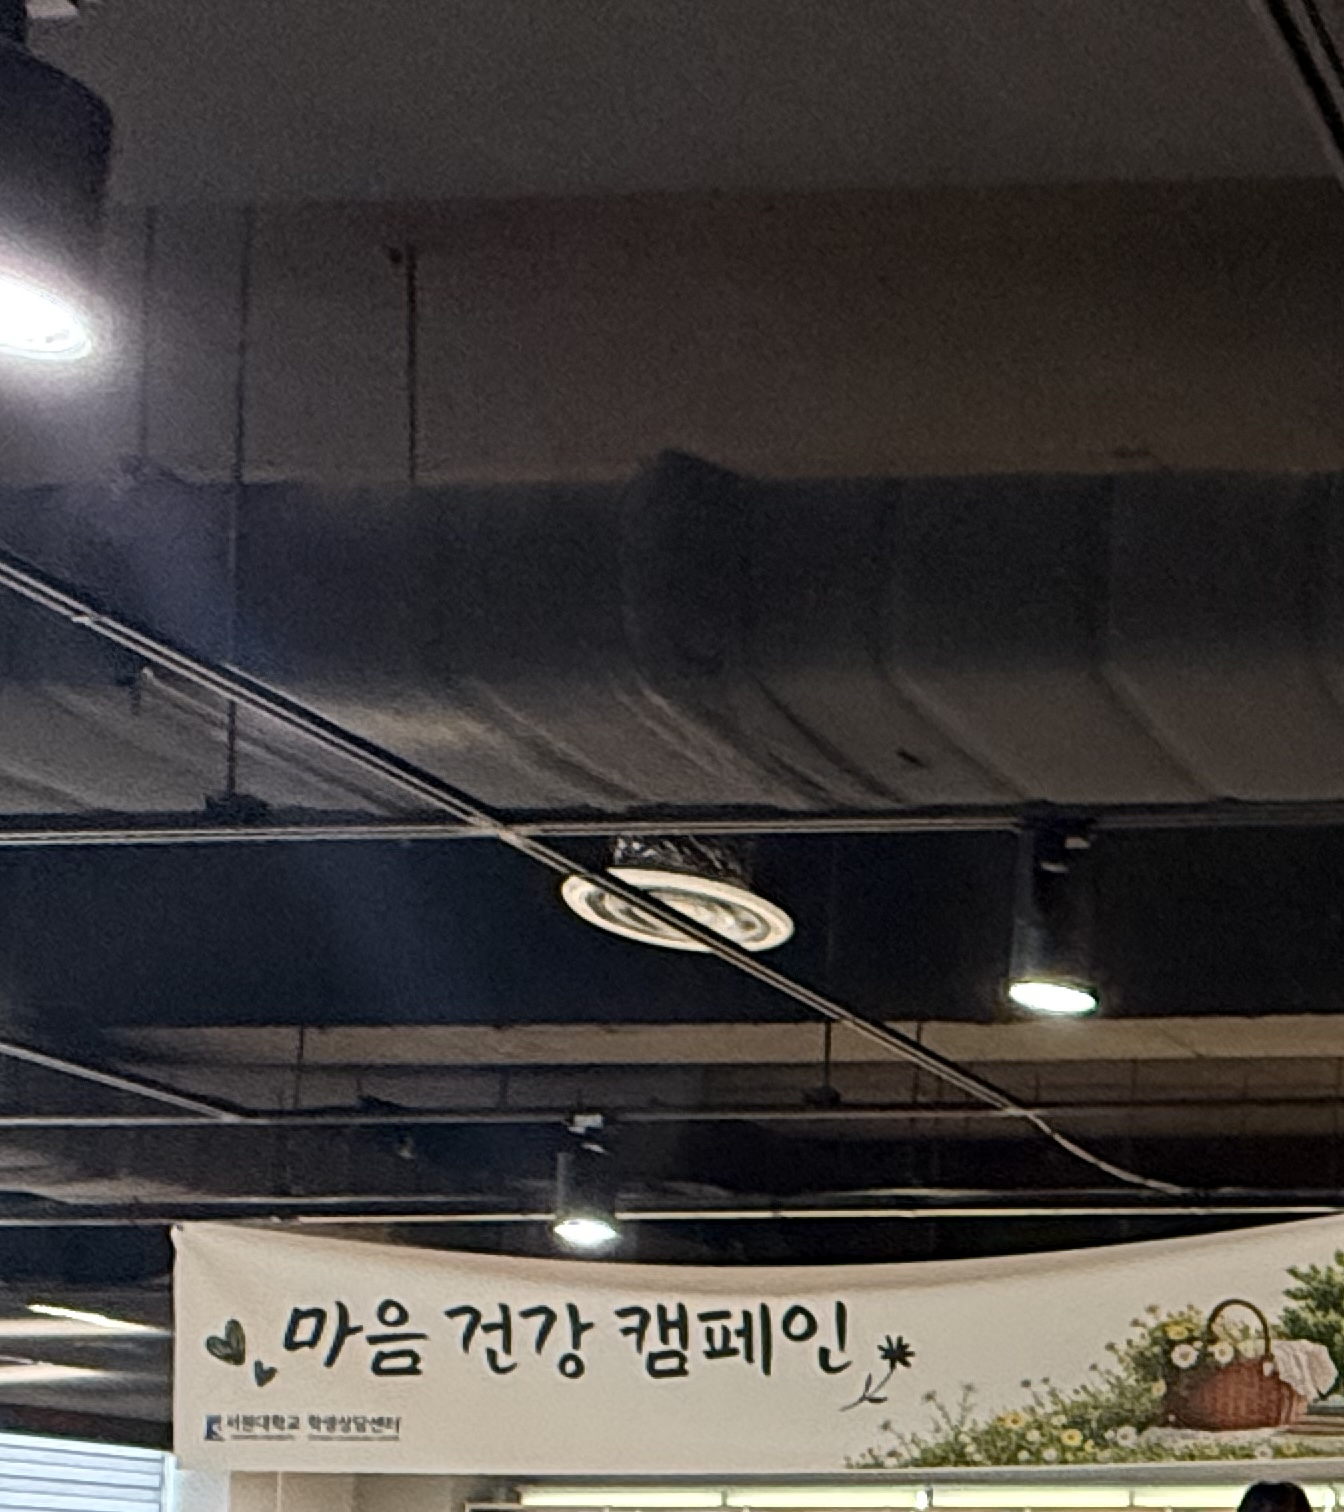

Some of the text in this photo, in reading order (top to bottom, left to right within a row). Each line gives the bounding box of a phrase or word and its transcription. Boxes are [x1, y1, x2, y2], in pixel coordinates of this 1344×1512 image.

[283, 1299, 853, 1380] 마음 건강 캠페인
